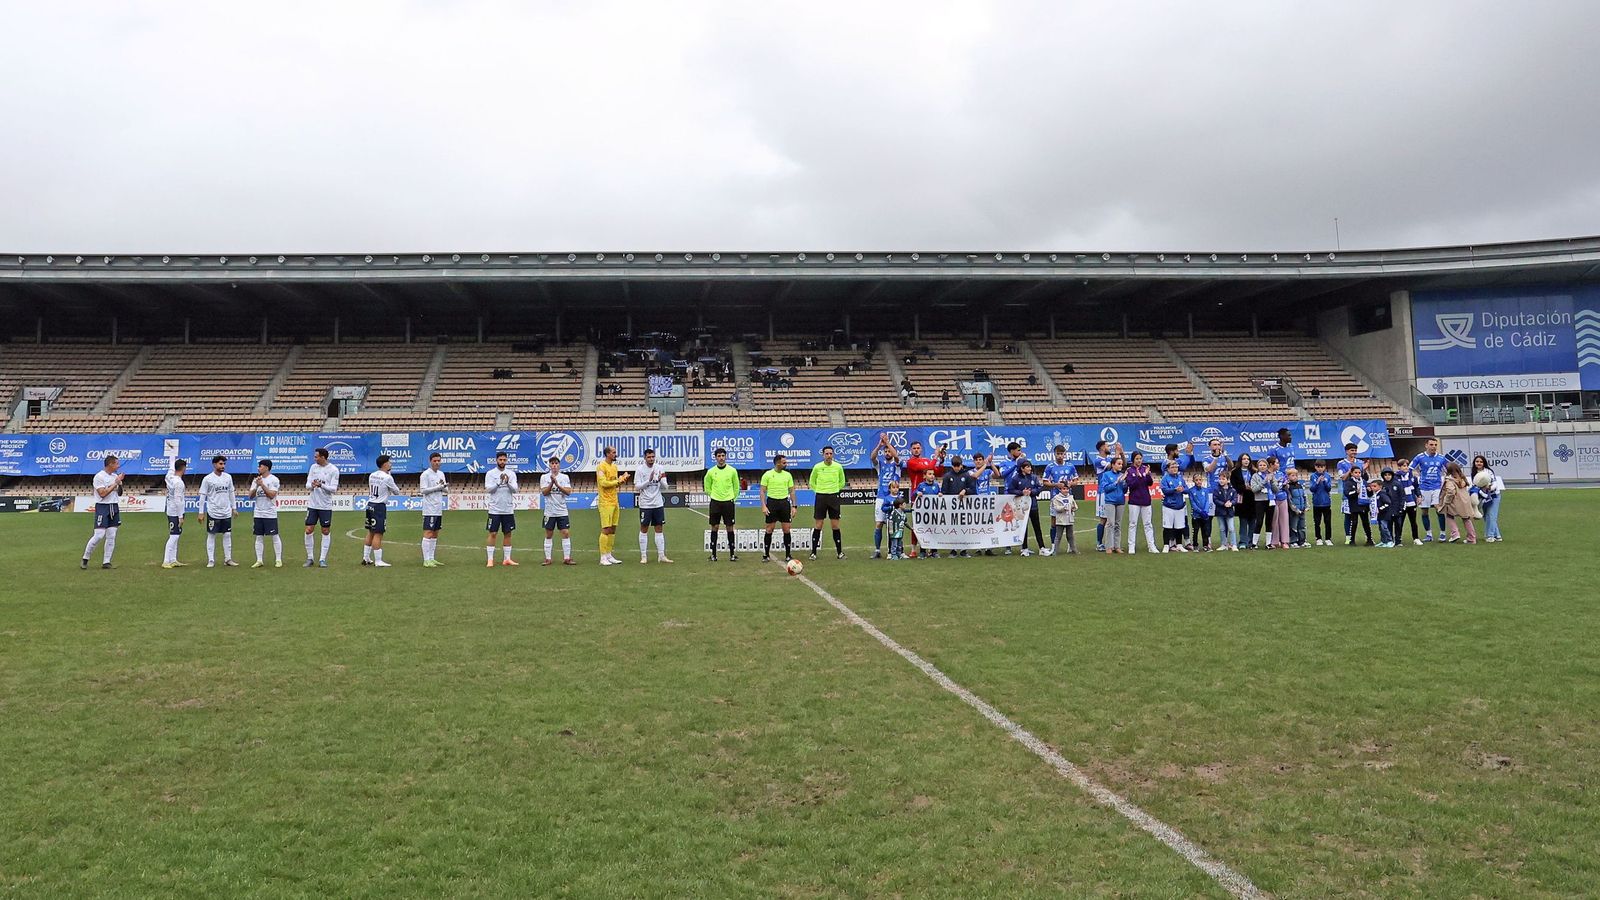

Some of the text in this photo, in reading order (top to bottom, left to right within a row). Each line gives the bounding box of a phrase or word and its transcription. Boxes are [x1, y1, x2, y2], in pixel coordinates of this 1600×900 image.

[1482, 310, 1571, 329] Diputación
[1484, 331, 1557, 348] de Cádiz
[1454, 377, 1567, 390] TUGASA HOTELES
[276, 435, 306, 445] MARKETING
[507, 442, 520, 450] Air
[711, 436, 754, 447] datono
[928, 430, 973, 451] GH
[596, 436, 635, 458] CIUDAD
[639, 436, 699, 458] DEPORTIVA
[1473, 448, 1531, 459] BUENAVISTA
[35, 455, 79, 464] san benito
[915, 496, 996, 510] DONA SANGRE
[915, 512, 994, 525] DONA MEDULA
